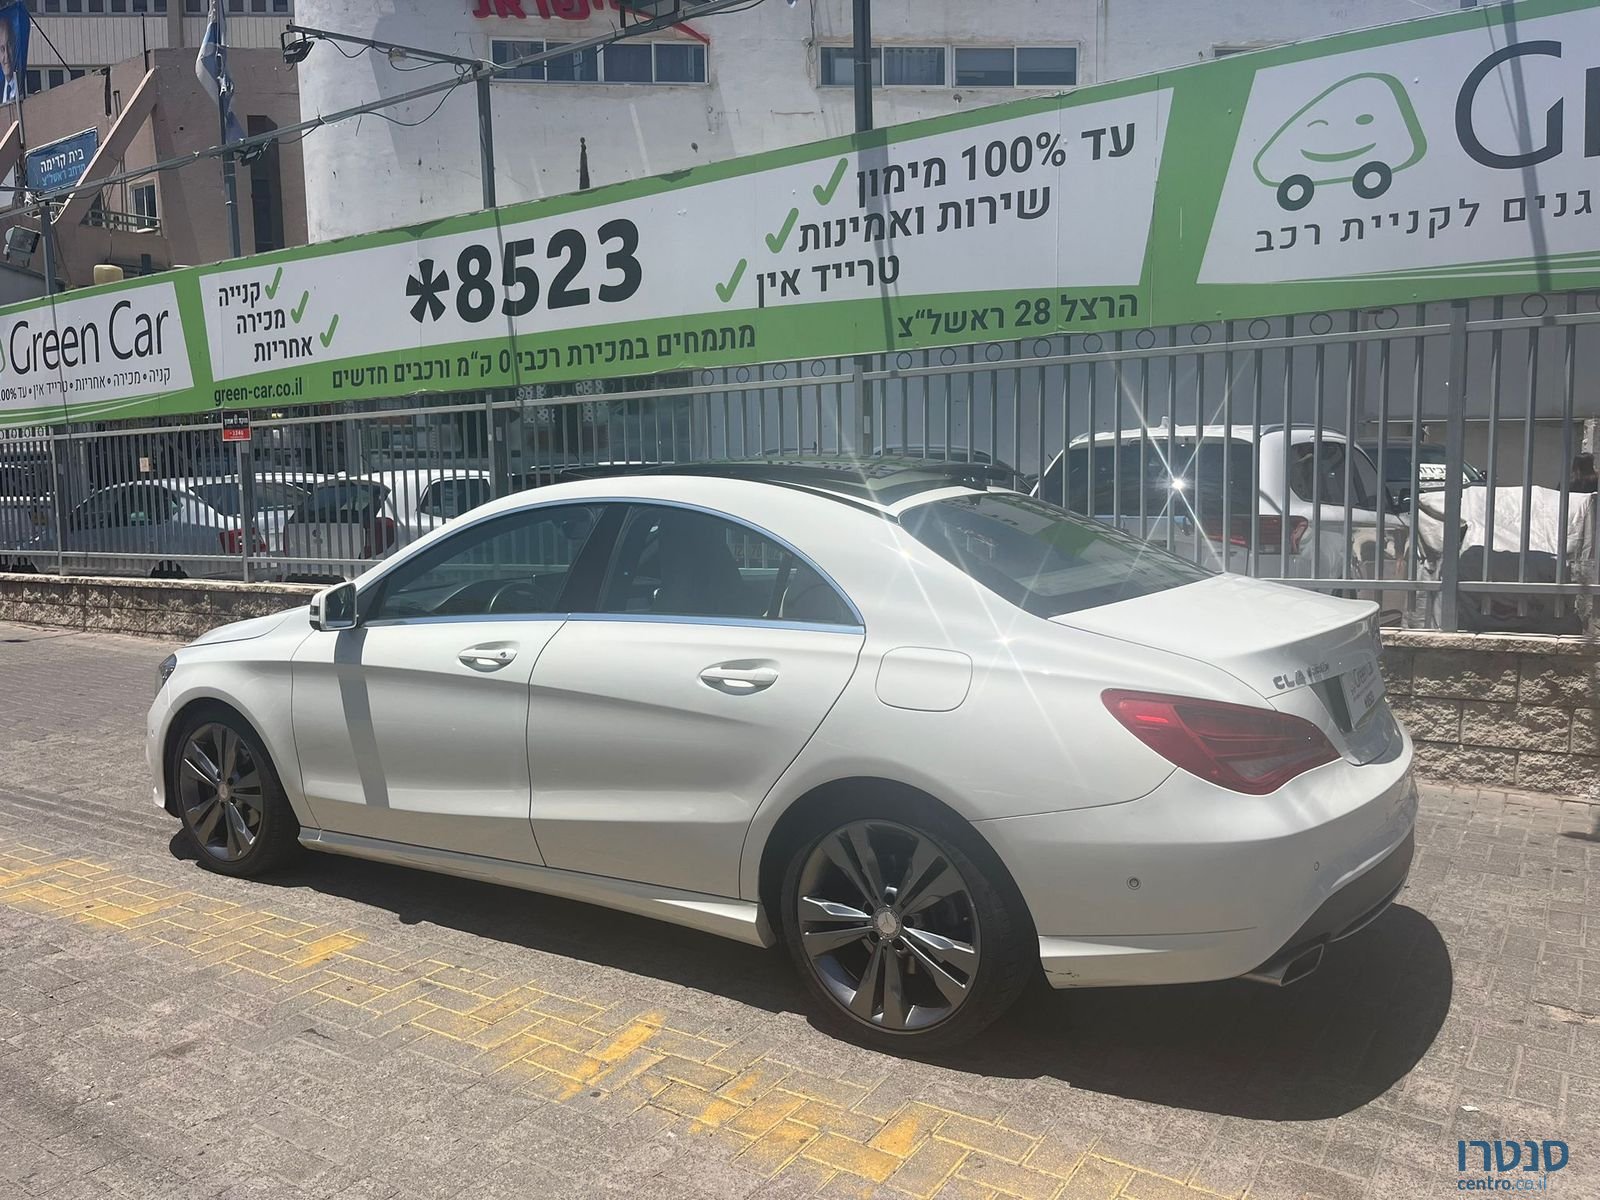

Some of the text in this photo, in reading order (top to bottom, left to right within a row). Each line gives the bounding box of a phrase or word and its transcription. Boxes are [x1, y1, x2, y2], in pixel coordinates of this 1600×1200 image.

[69, 149, 84, 164] בית
[857, 123, 1135, 208] עד 100% מימון
[798, 186, 1050, 252] שירות ואמינות
[1340, 198, 1480, 242] לקניית
[1255, 224, 1321, 252] רכב
[756, 255, 900, 308] טרייד אין
[218, 282, 260, 308] קנייה
[1061, 293, 1138, 322] הרצל
[236, 309, 285, 334] מכירה
[1014, 298, 1051, 327] 28
[10, 300, 169, 375] Green Car
[254, 336, 313, 363] אחריות
[657, 324, 755, 356] מתמחים
[499, 349, 511, 373] 0
[516, 347, 560, 371] רכבי
[567, 337, 650, 367] במכירת
[75, 375, 105, 392] אחריות
[113, 371, 141, 387] מכירה
[149, 367, 171, 386] קניה
[332, 365, 388, 389] חדשים
[394, 359, 450, 383] ורכבים
[17, 386, 28, 398] עד
[33, 384, 45, 400] אין
[214, 377, 302, 406] green-car.co.il
[1272, 670, 1306, 690] CLA
